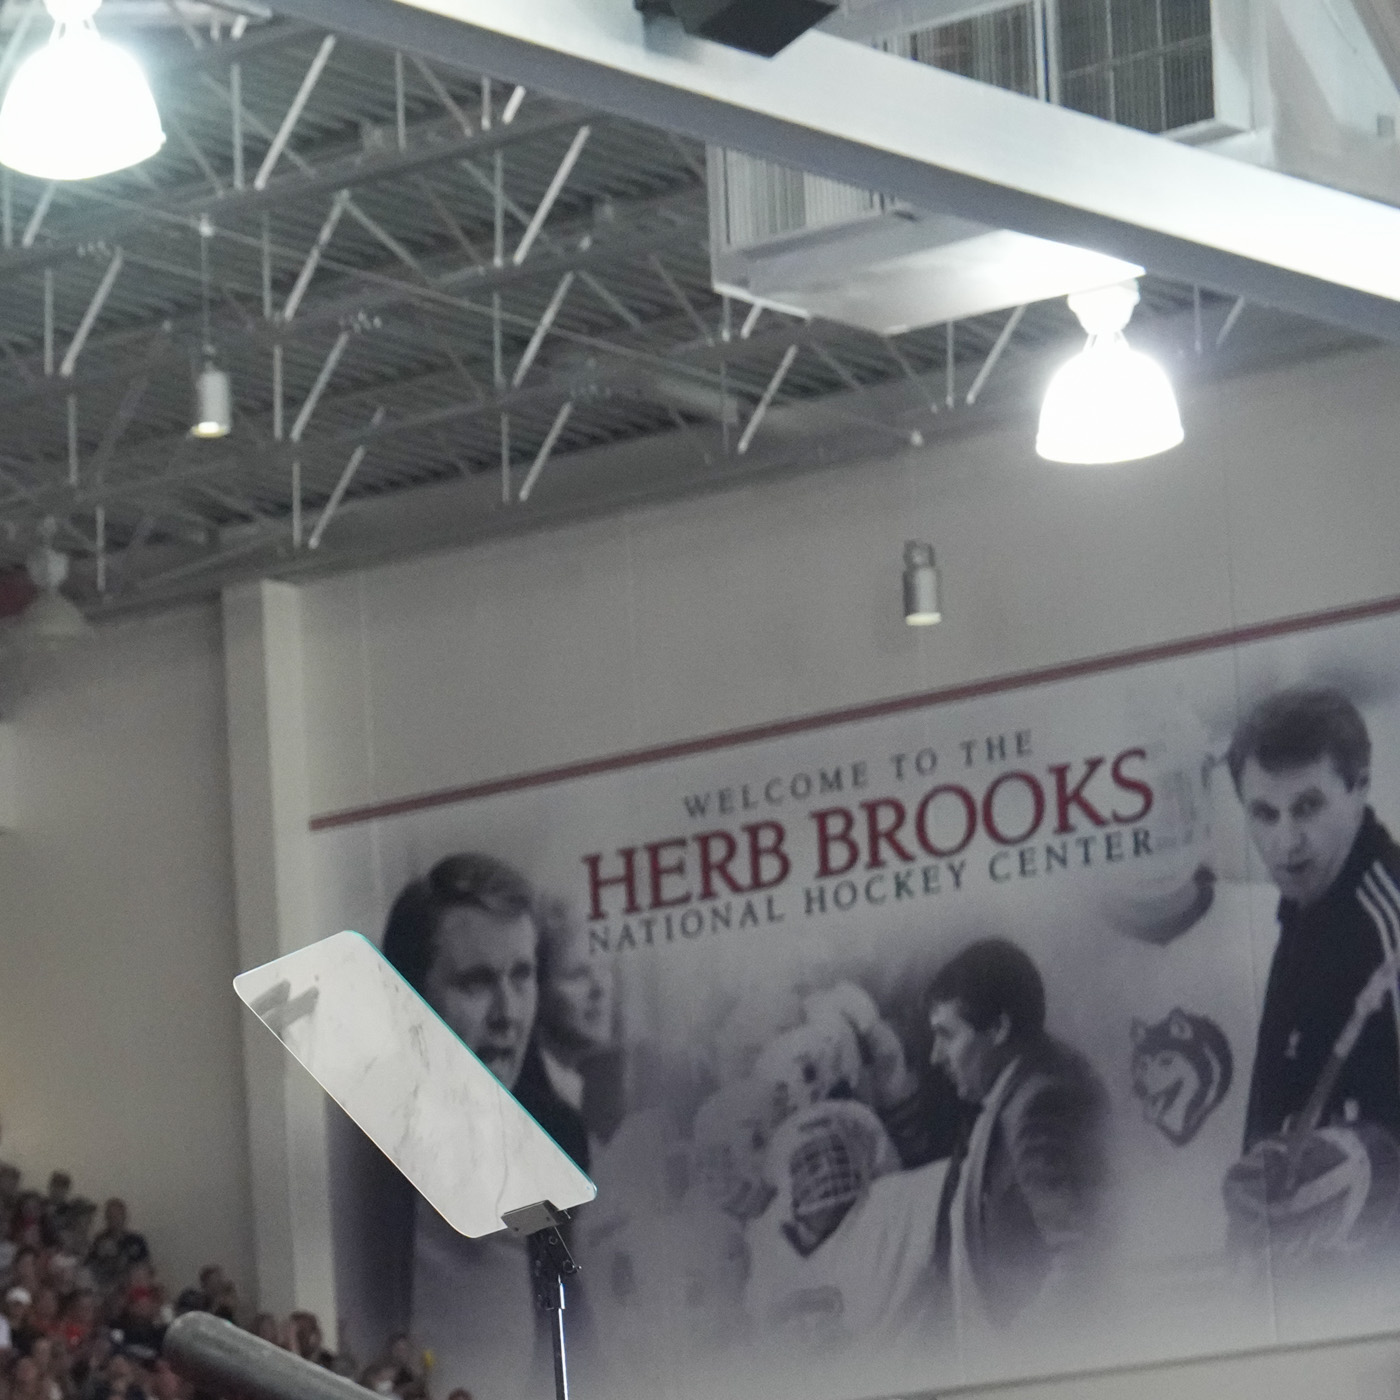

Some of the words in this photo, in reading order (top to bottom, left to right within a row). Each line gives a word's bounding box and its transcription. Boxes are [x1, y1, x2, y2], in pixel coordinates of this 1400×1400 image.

[581, 819, 792, 922] HERB
[810, 747, 1154, 880] BROOKS
[684, 760, 869, 818] WELCOME
[891, 747, 938, 781] TO
[960, 728, 1032, 767] THE
[587, 894, 786, 954] NATIONAL
[803, 859, 967, 917] HOCKEY
[988, 827, 1153, 884] CENTER
